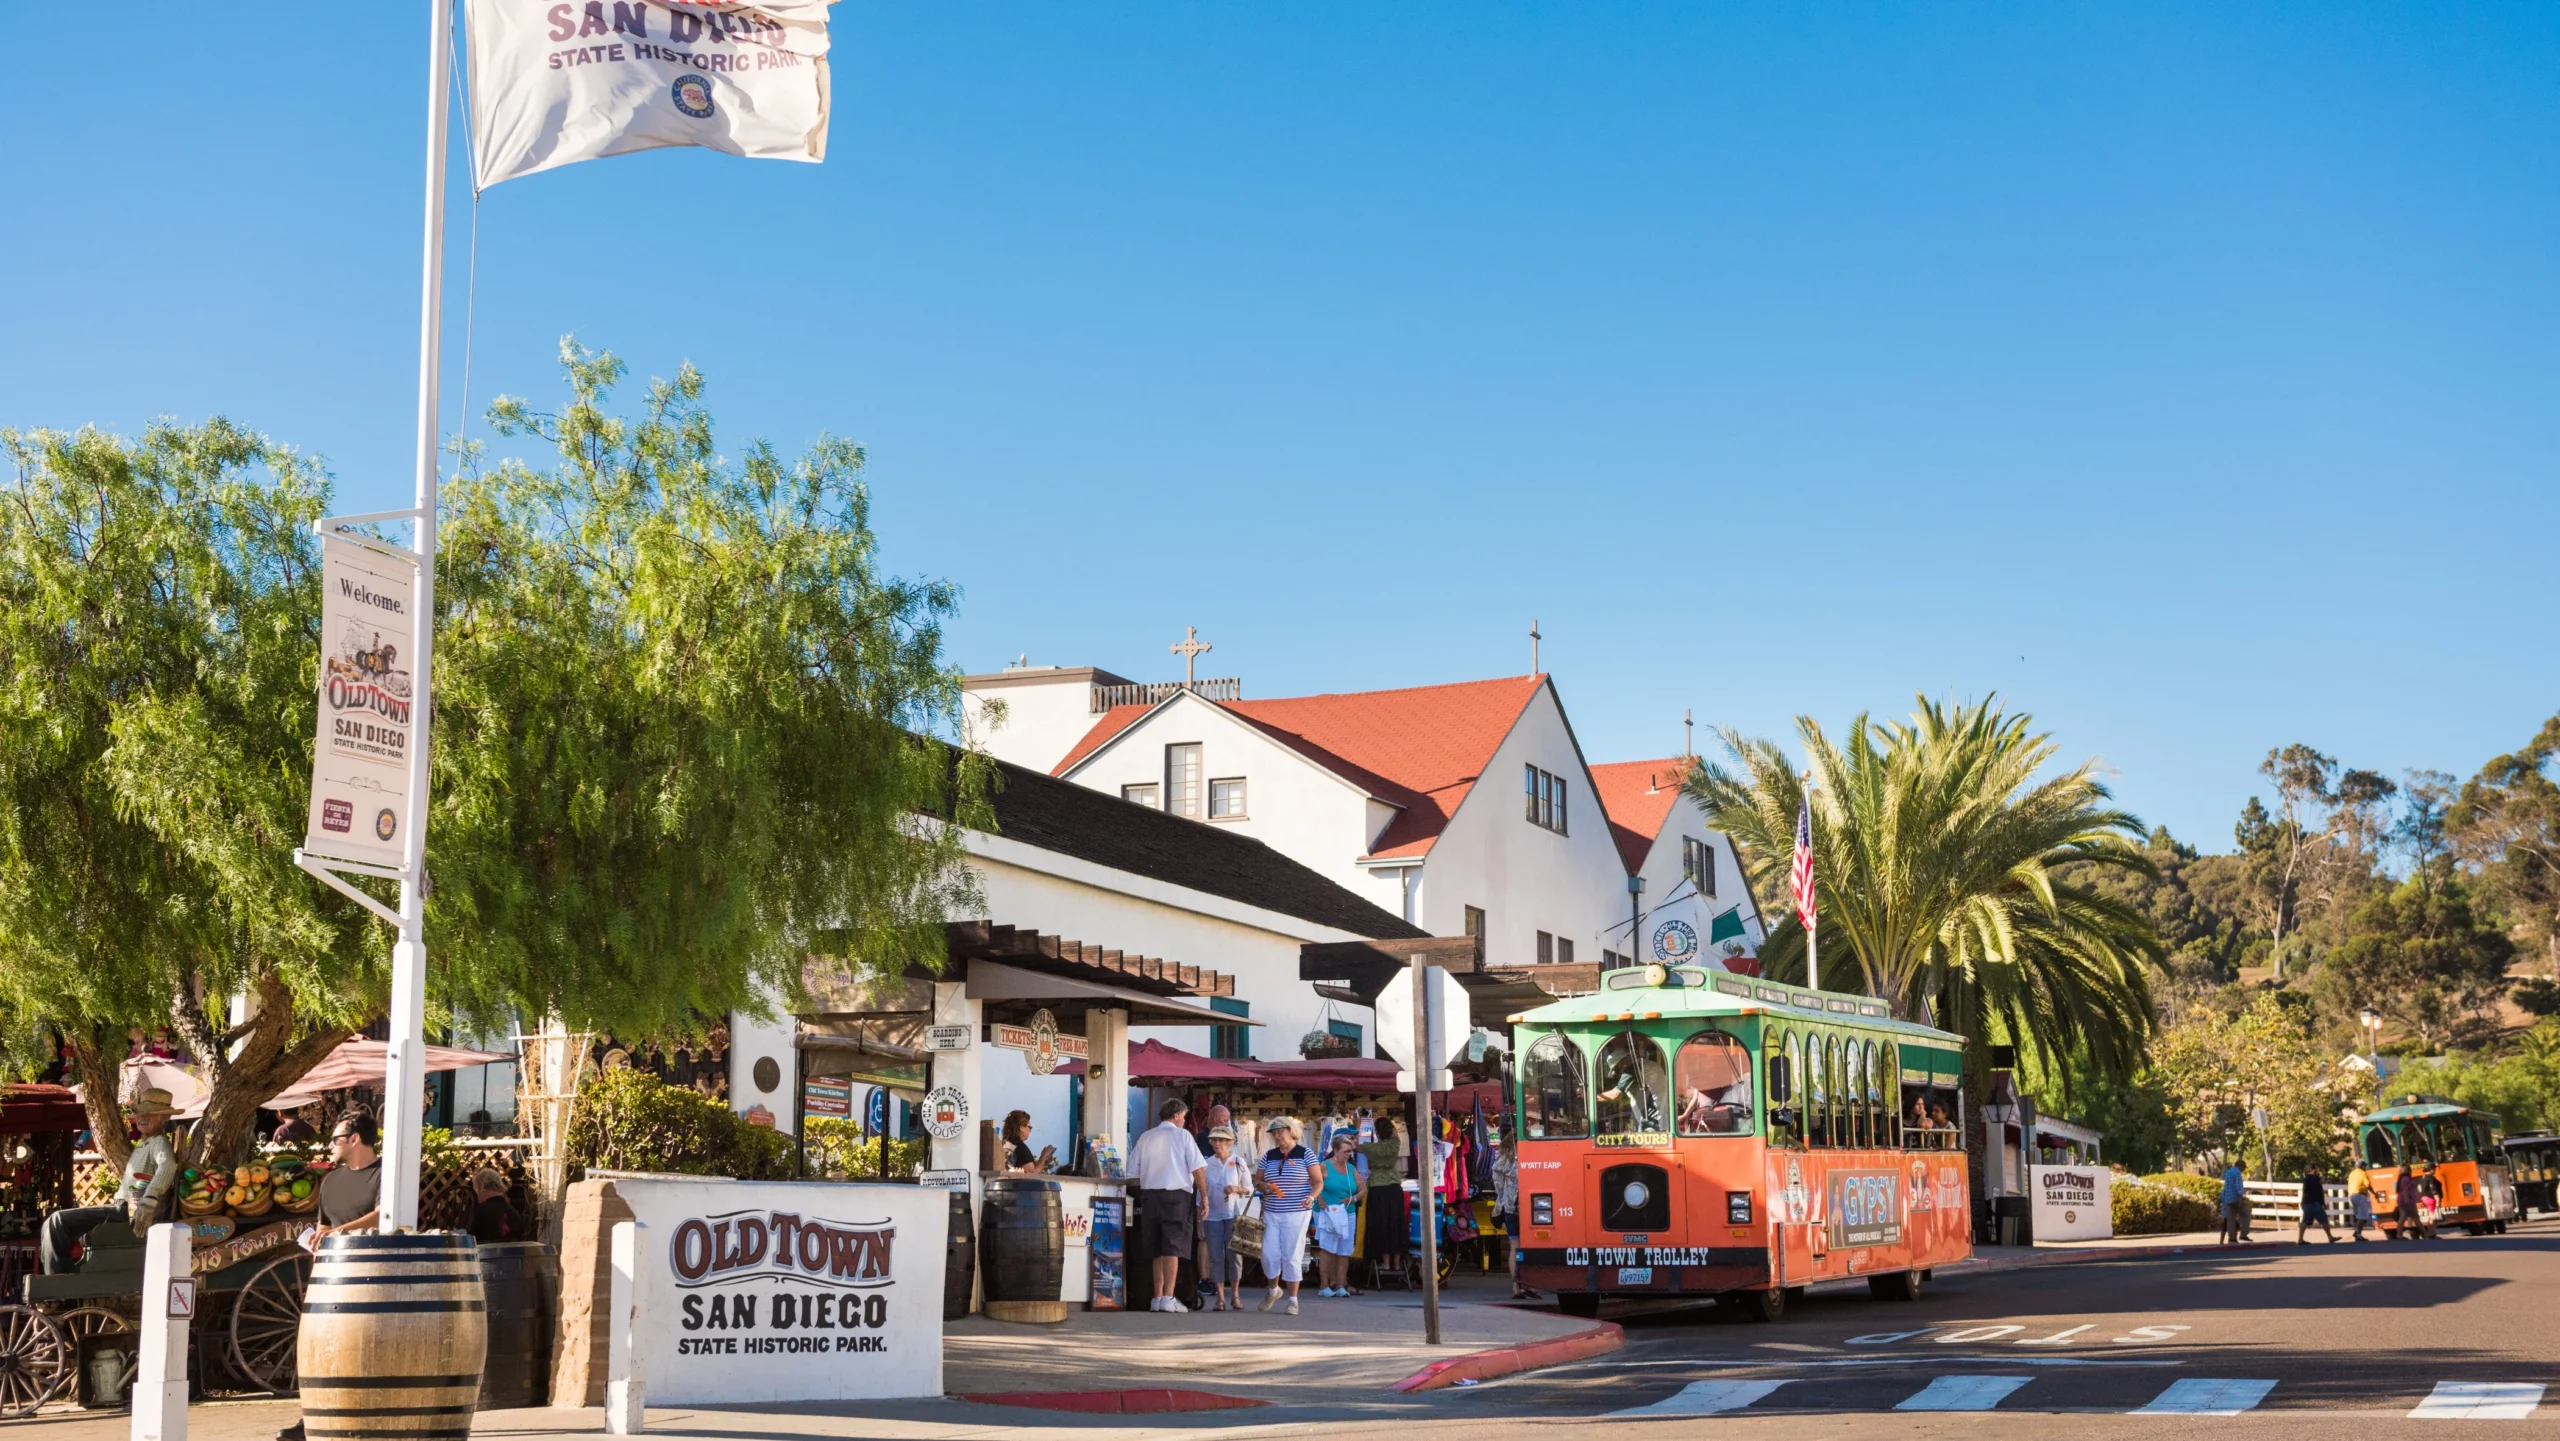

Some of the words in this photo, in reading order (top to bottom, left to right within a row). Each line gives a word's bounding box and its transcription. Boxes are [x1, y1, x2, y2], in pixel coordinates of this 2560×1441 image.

[547, 1, 648, 42] SAN
[549, 44, 625, 70] STATE
[635, 43, 750, 72] HISTORIC
[340, 578, 404, 614] Welcome.
[336, 718, 362, 743] SAN
[366, 723, 405, 748] DIEGO
[334, 737, 355, 749] STATE
[356, 742, 386, 756] HISTORIC
[325, 803, 351, 813] FIESTA
[324, 817, 349, 827] REYES
[933, 1028, 961, 1038] BOARDING
[1001, 1028, 1031, 1046] TICKETS
[940, 1039, 955, 1047] HERE
[1059, 1037, 1072, 1052] FREE
[1073, 1039, 1087, 1053] MAPS
[828, 1089, 845, 1097] Kitchen
[923, 1096, 932, 1118] OLD
[930, 1086, 946, 1103] TOWN
[948, 1087, 968, 1117] TROLLEY
[930, 1121, 963, 1138] TOURS
[1596, 1134, 1624, 1146] CITY
[1627, 1133, 1668, 1145] TOURS
[922, 1177, 967, 1187] RECYCLABLES
[1844, 1176, 1896, 1225] GYPSY
[2046, 1191, 2063, 1200] SAN
[2066, 1191, 2094, 1201] DIEGO
[1559, 1207, 1573, 1217] 113
[225, 1231, 278, 1262] Town
[1623, 1235, 1647, 1243] SVMC
[1566, 1248, 1589, 1266] OLD
[1596, 1248, 1636, 1266] TOWN
[1644, 1248, 1709, 1266] TROLLEY
[681, 1293, 756, 1330] SAN
[770, 1293, 887, 1330] DIEGO
[678, 1337, 737, 1354] STATE
[744, 1336, 830, 1353] HISTORIC
[836, 1336, 888, 1353] PARK.
